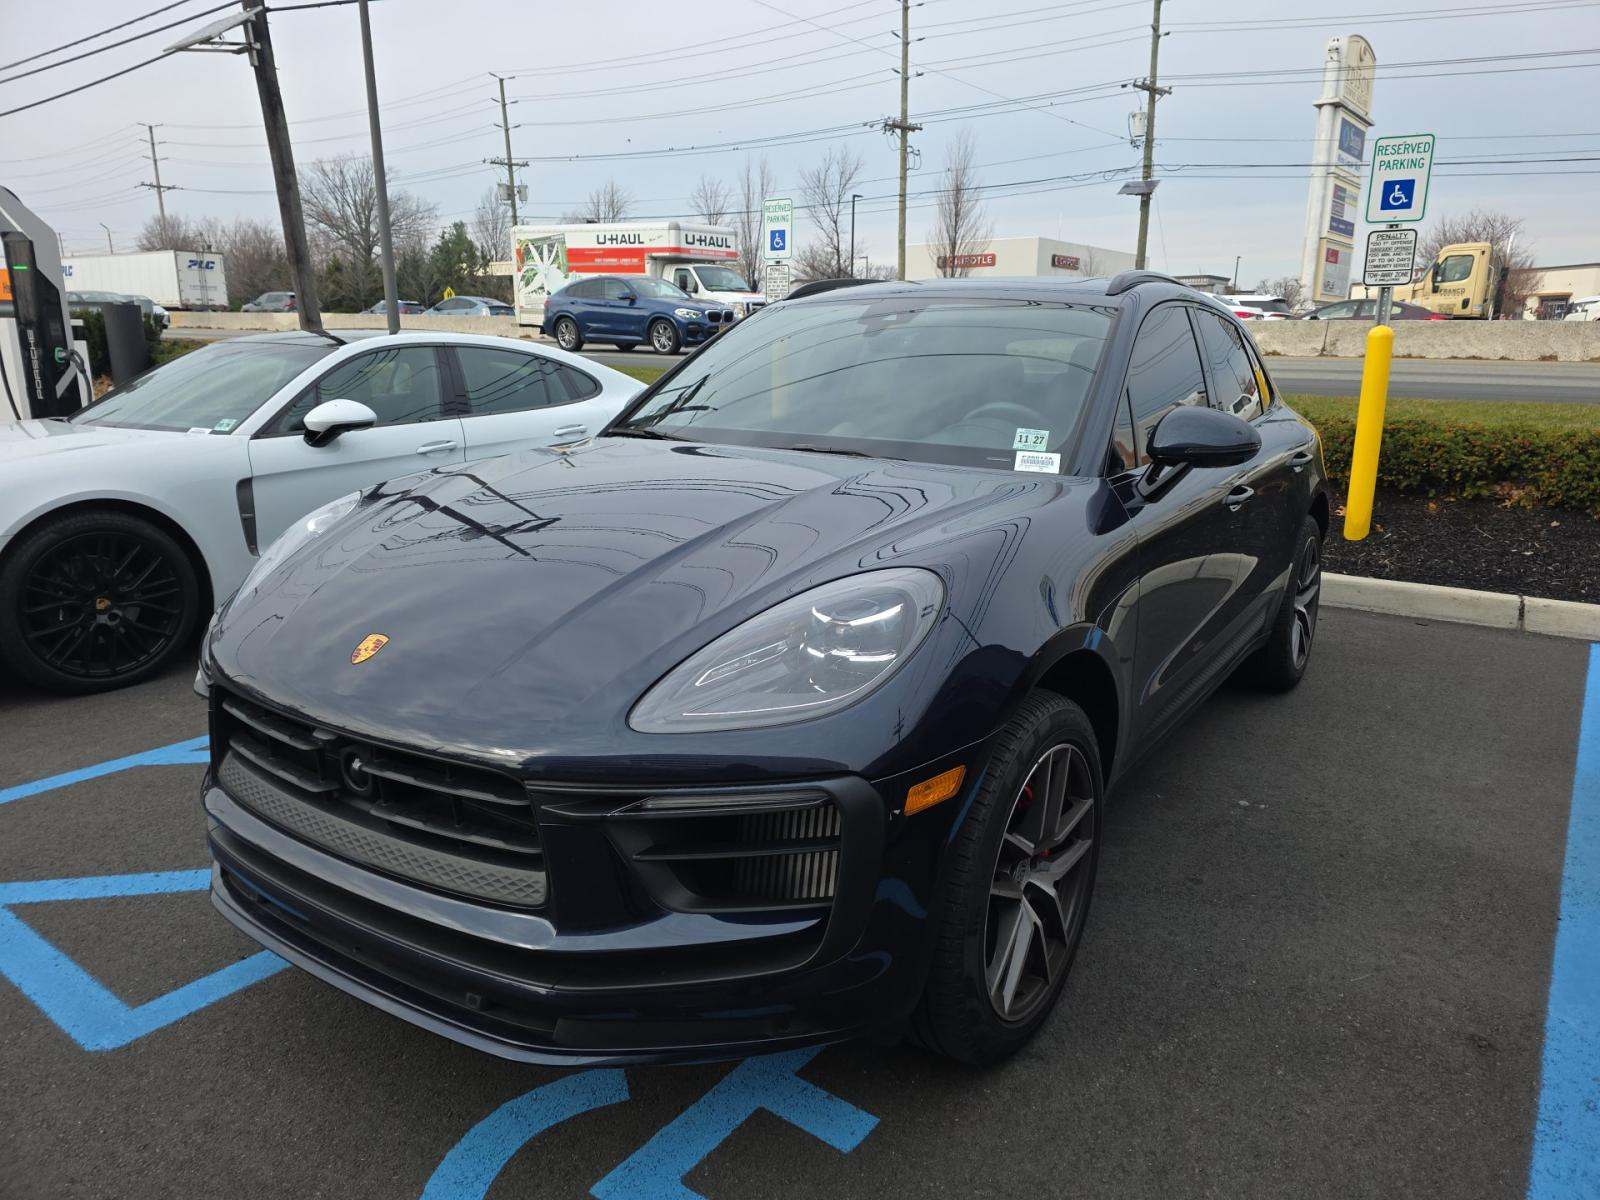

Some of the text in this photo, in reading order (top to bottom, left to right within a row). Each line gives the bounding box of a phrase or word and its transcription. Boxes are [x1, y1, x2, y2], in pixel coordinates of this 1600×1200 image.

[1377, 142, 1431, 156] RESERVED
[1379, 157, 1425, 171] PARKING
[765, 203, 790, 213] RESERVED
[767, 214, 789, 223] PARKING
[597, 234, 644, 245] U-HAUL
[685, 233, 731, 248] U-HAUL
[188, 259, 215, 270] PLC
[950, 254, 992, 265] HIPOTLE
[27, 329, 44, 400] PORSCHE
[1033, 436, 1045, 444] 27
